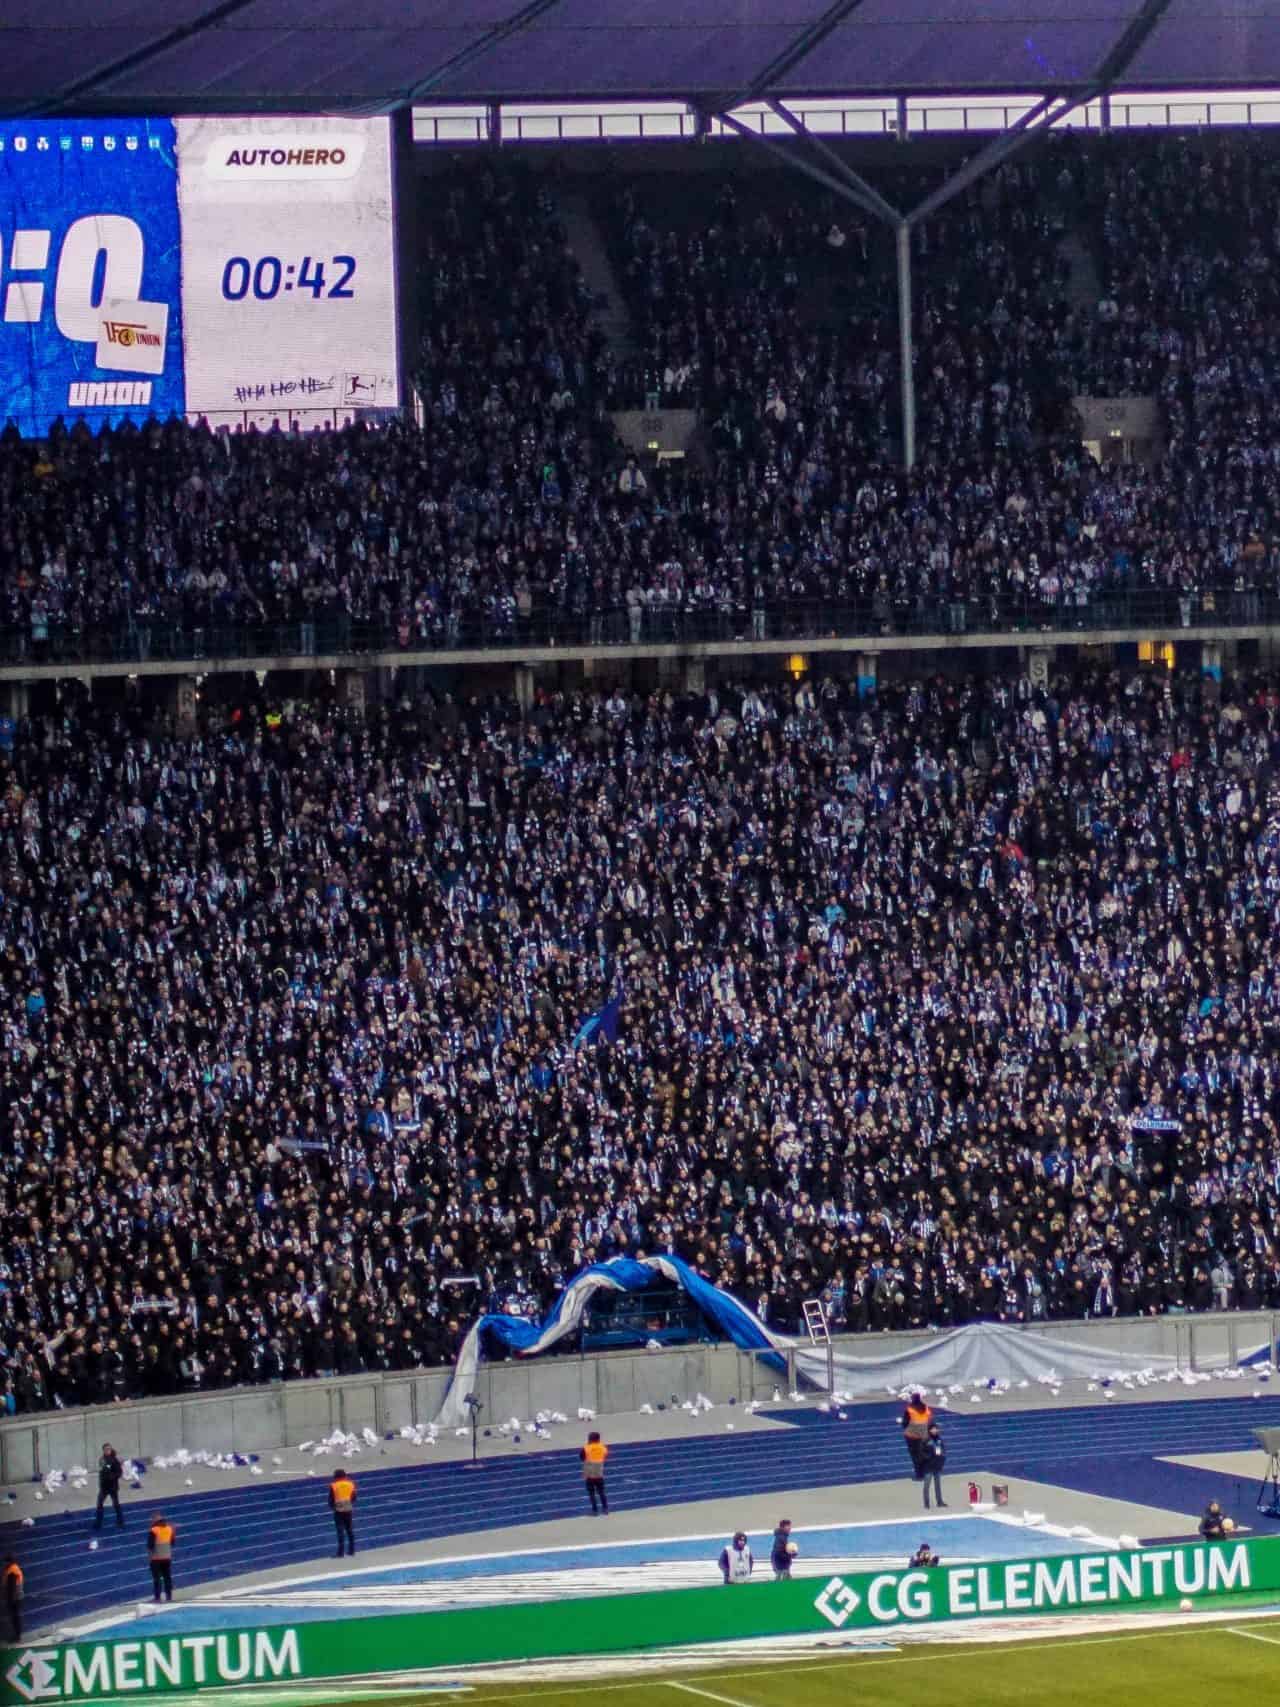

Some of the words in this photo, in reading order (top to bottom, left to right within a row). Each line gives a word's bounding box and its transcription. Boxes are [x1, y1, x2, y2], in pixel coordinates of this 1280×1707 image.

[226, 148, 346, 166] AUTOHERO
[222, 255, 356, 300] 00:42
[868, 1573, 930, 1621] CG
[949, 1543, 1251, 1615] ELEMENTUM
